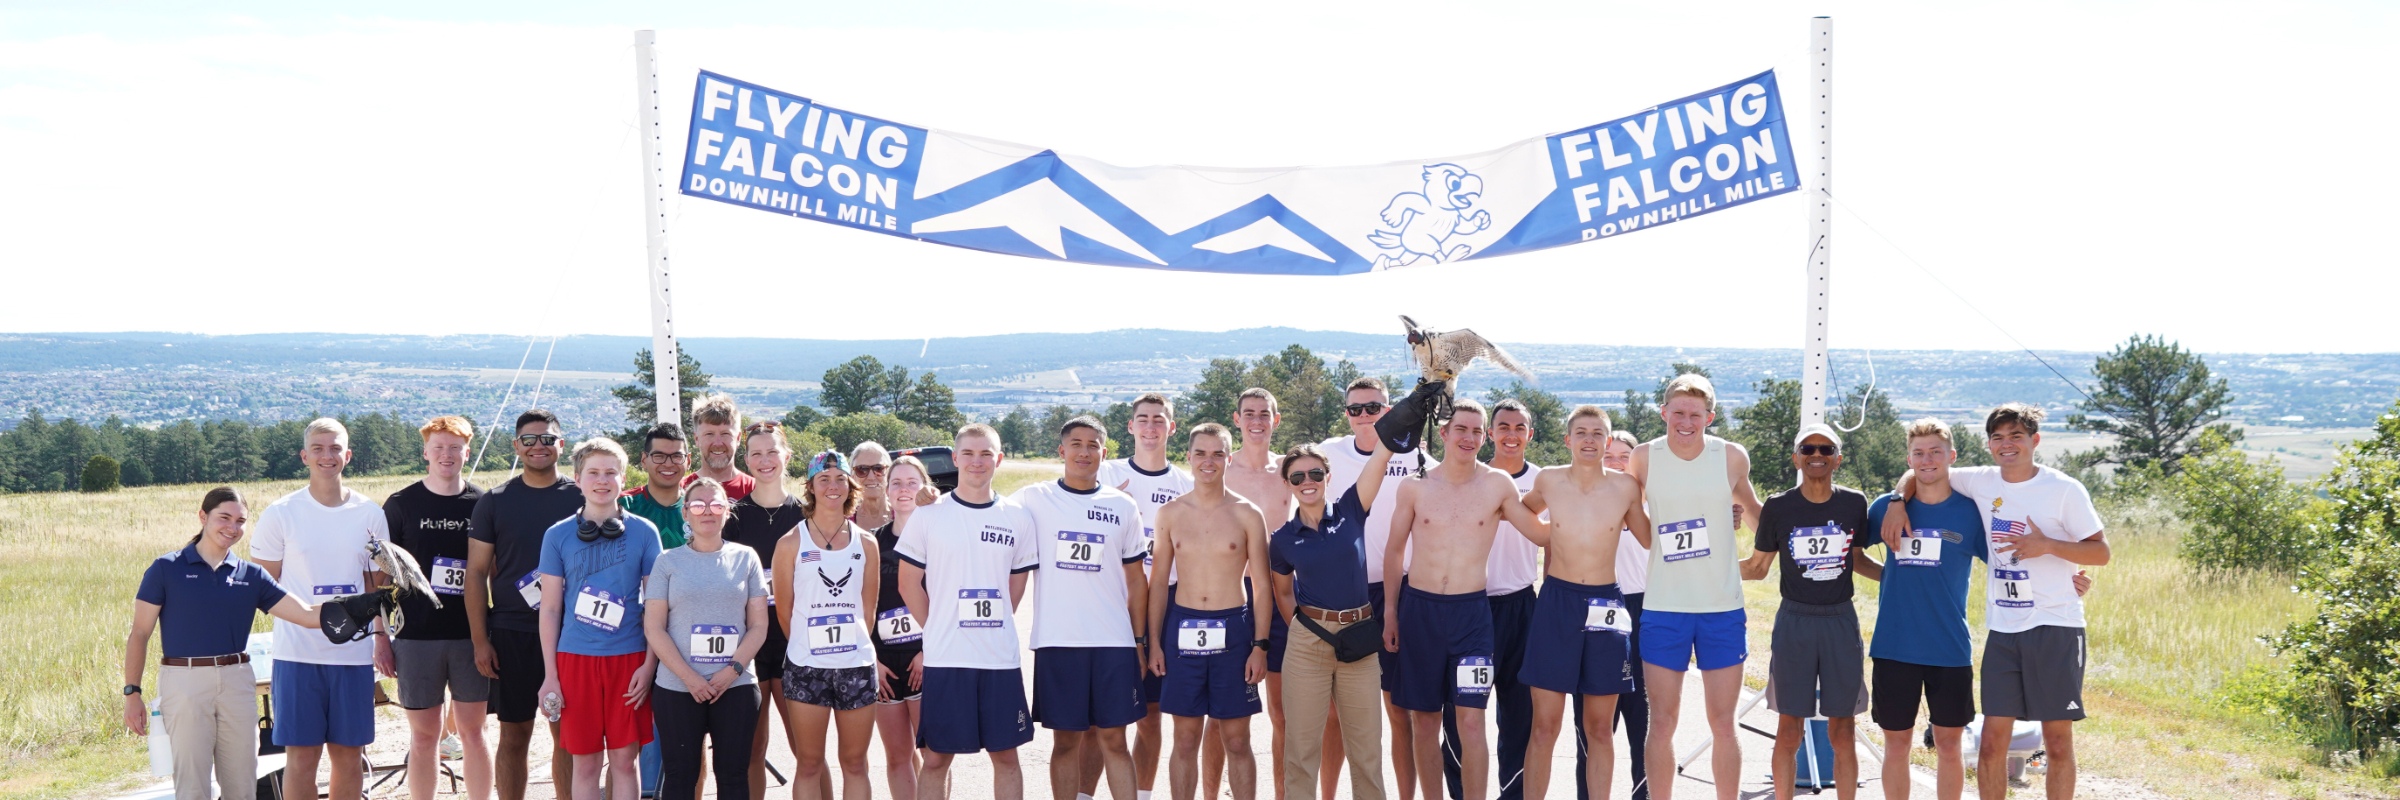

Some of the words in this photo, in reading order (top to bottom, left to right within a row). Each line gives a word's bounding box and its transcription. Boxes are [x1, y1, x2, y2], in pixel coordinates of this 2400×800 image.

[702, 78, 908, 168] FLYING
[1560, 83, 1767, 179] FLYING
[694, 128, 898, 210] FALCON
[1572, 128, 1777, 223] FALCON
[690, 174, 827, 217] DOWNHILL
[837, 203, 897, 230] MILE
[1582, 194, 1716, 241] DOWNHILL
[1725, 171, 1785, 203] MILE
[419, 518, 465, 531] Hurley
[1087, 510, 1121, 526] USAFA
[981, 531, 1015, 548] USAFA
[1675, 531, 1693, 550] 27
[1808, 537, 1829, 555] 32
[1911, 539, 1922, 556] 9
[1070, 543, 1091, 561] 20
[445, 569, 464, 586] 33
[2004, 582, 2018, 598] 14
[592, 600, 609, 618] 11
[974, 600, 991, 617] 18
[1605, 609, 1616, 625] 8
[825, 626, 841, 643] 17
[891, 616, 911, 635] 26
[706, 636, 725, 654] 10
[1197, 630, 1207, 647] 3
[1471, 668, 1488, 684] 15
